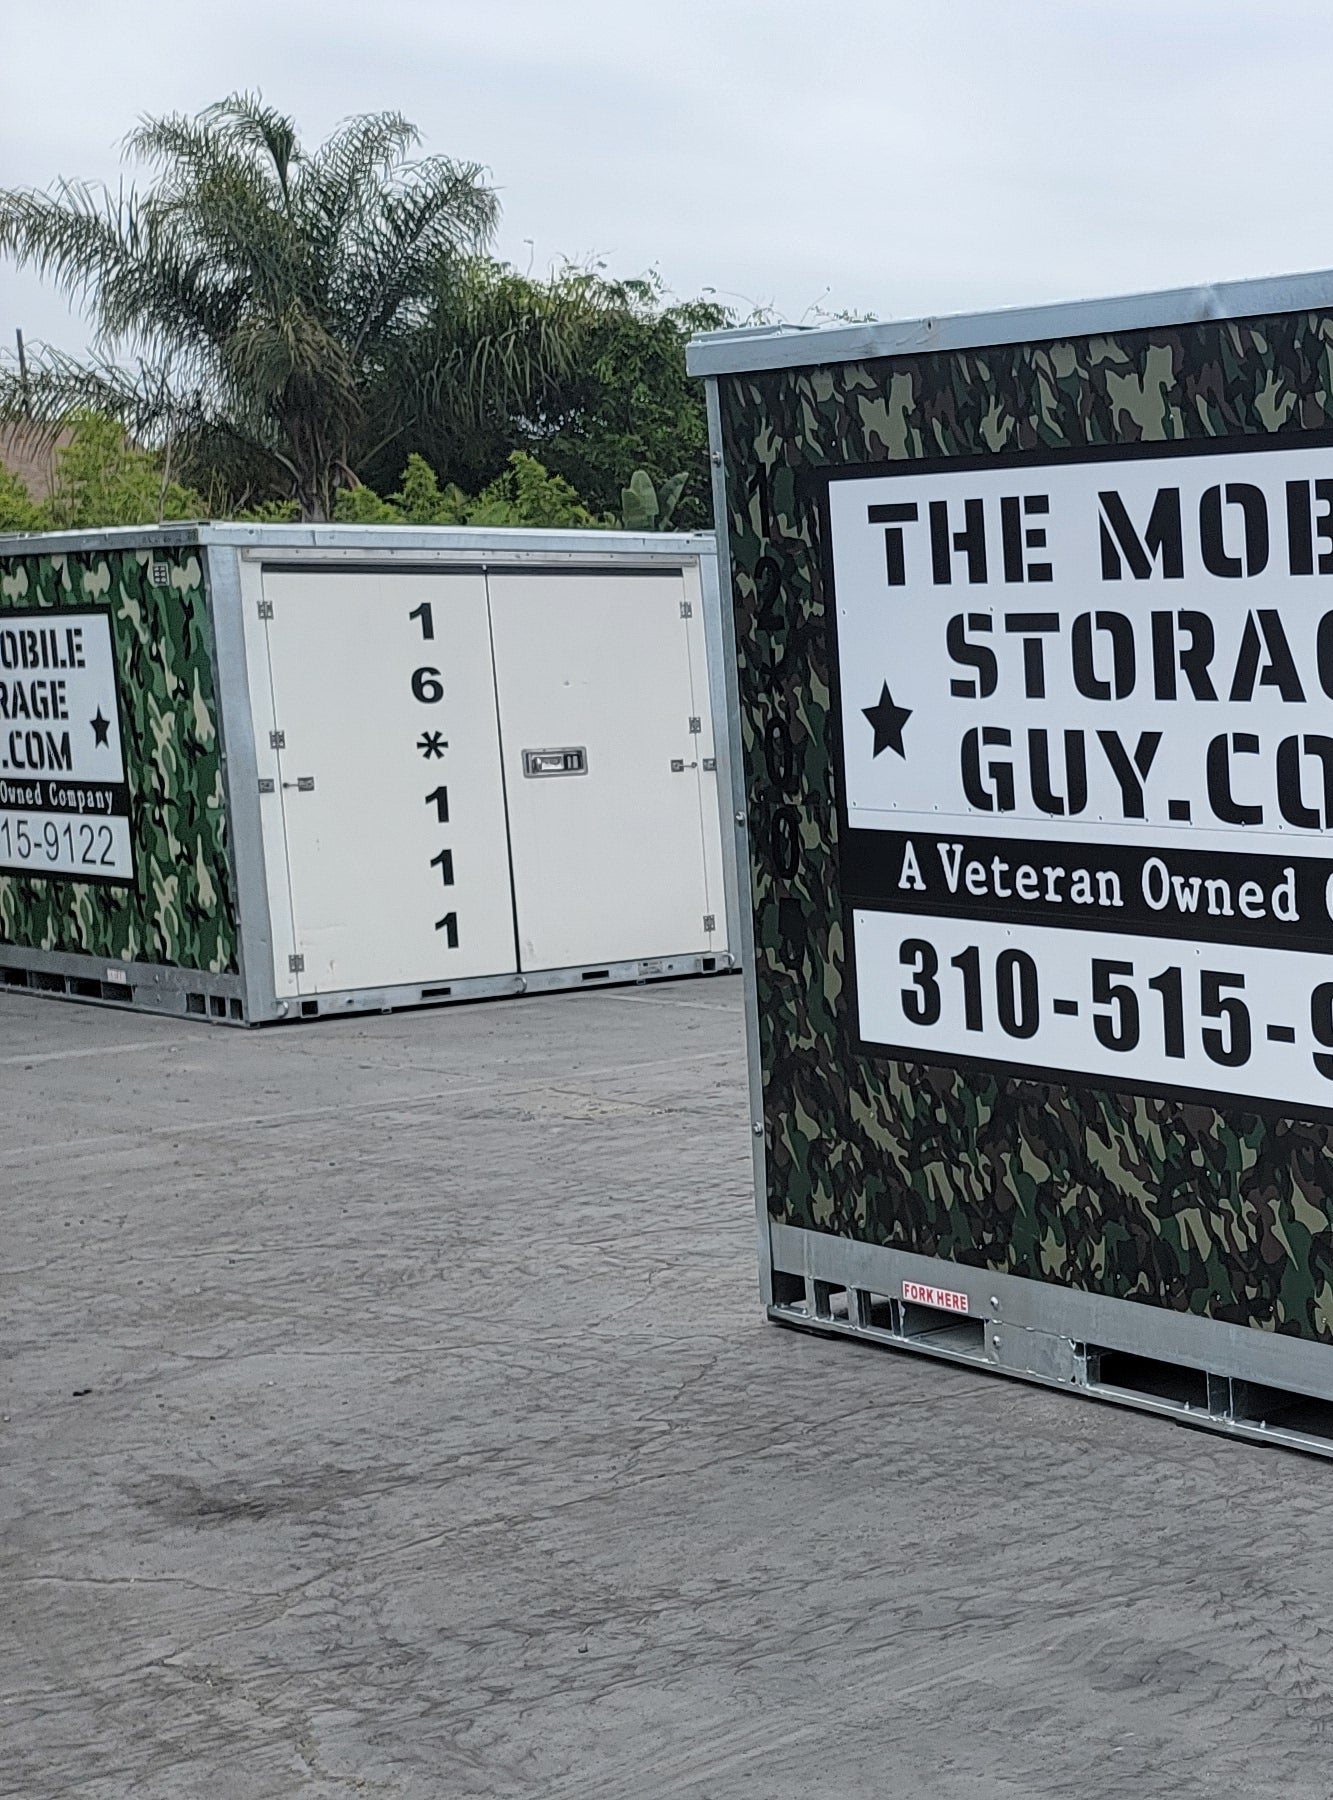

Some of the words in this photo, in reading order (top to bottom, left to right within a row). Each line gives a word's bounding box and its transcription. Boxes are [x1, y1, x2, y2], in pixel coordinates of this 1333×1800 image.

[867, 494, 1054, 587] THE
[49, 782, 113, 815] Company
[897, 840, 928, 891] A
[937, 844, 1123, 909] Veteran
[1141, 857, 1301, 923] Owned
[904, 1283, 934, 1304] FORK
[936, 1290, 967, 1311] HERE
